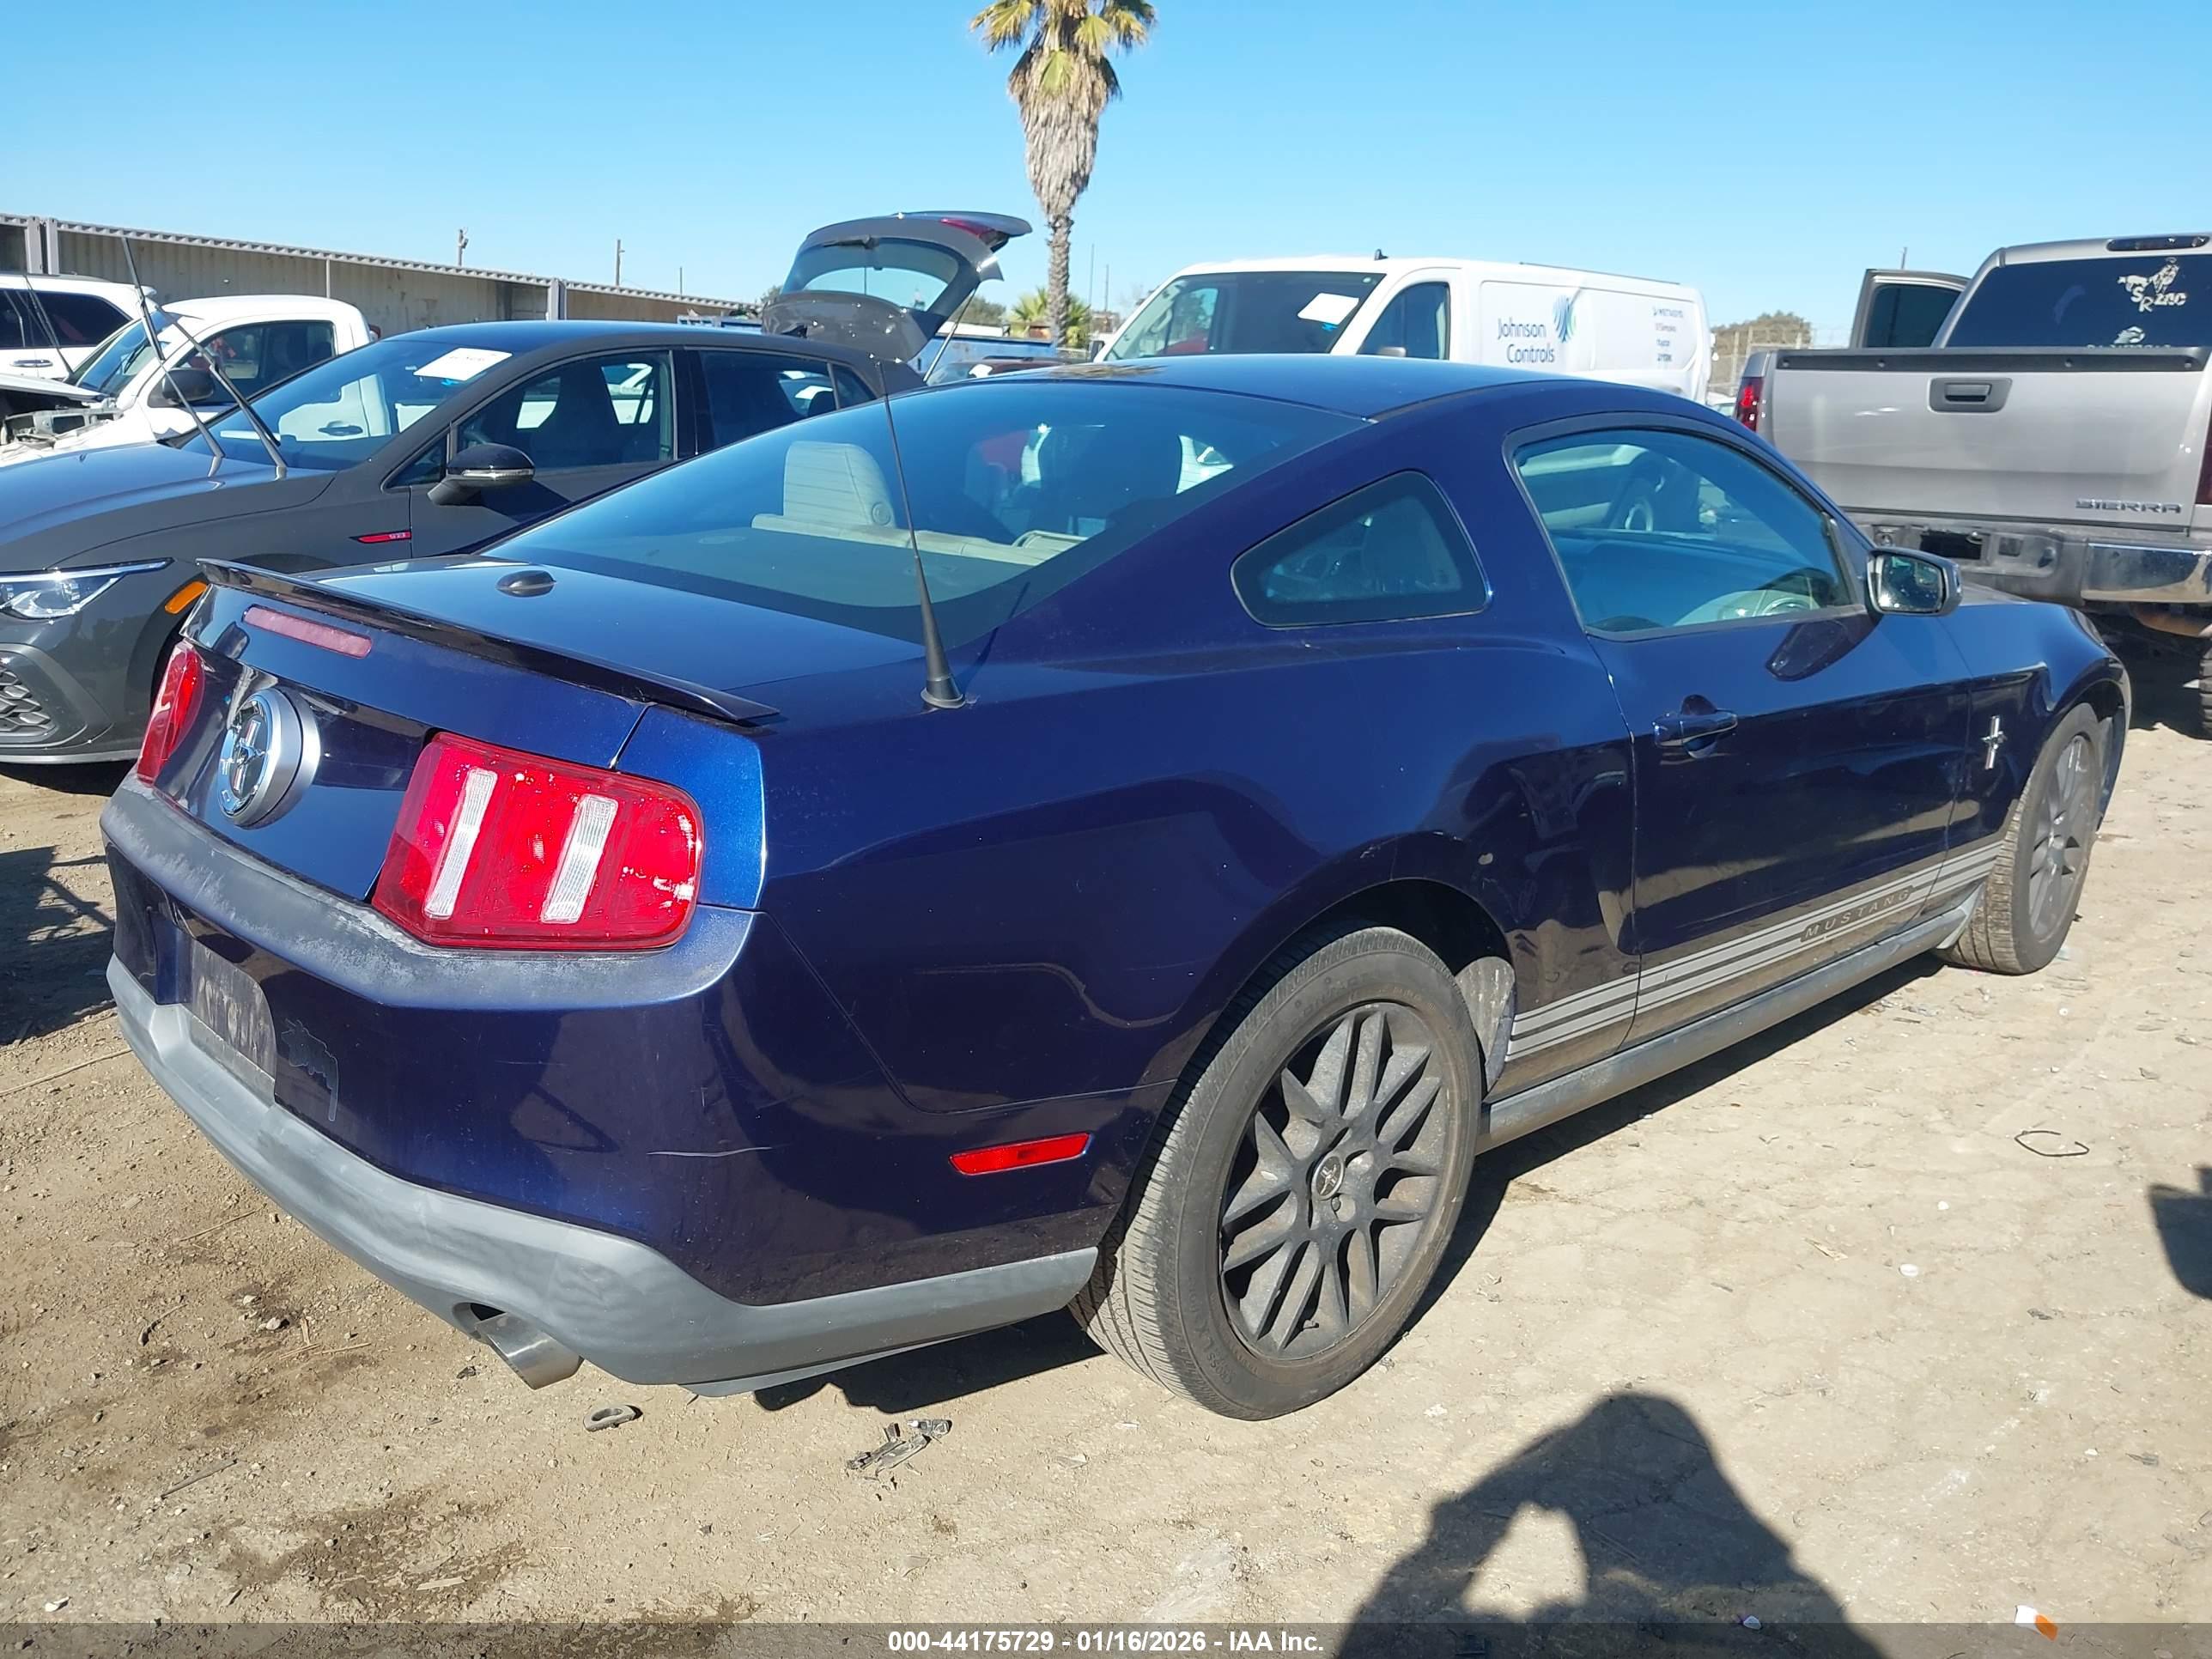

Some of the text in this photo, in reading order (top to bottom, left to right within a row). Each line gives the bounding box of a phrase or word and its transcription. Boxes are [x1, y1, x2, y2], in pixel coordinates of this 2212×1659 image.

[1498, 317, 1547, 340] Johnson
[1506, 343, 1555, 363] Controls
[2075, 499, 2182, 514] SIERRA
[1805, 890, 1910, 938] MUSTANG
